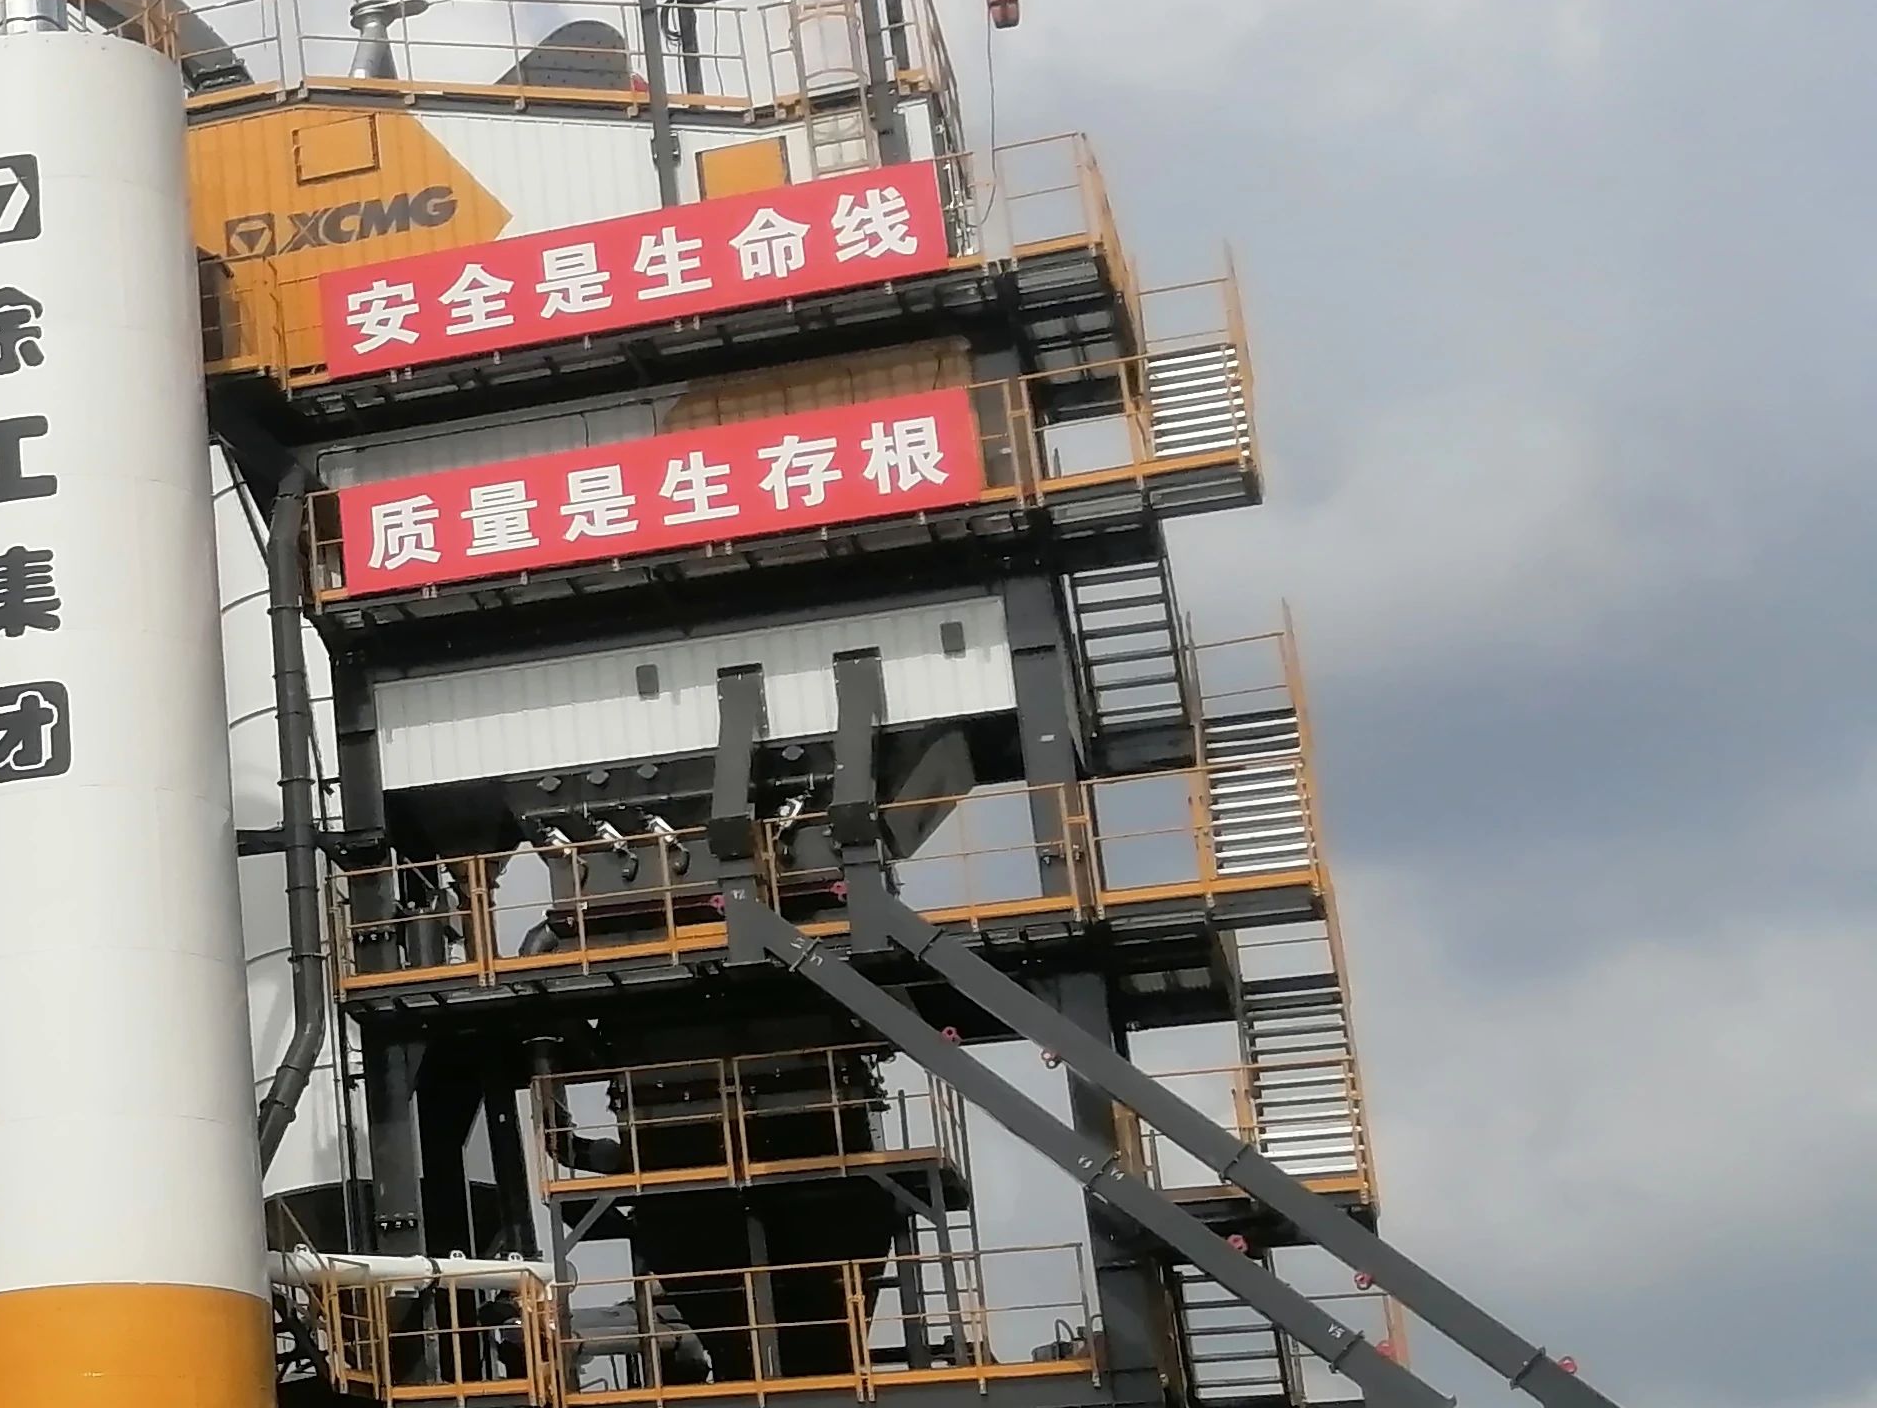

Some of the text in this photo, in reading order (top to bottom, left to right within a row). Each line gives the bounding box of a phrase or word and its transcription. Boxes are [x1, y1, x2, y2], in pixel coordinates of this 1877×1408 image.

[278, 185, 458, 255] XCMG
[345, 186, 919, 356] 安全是生命线
[367, 414, 950, 572] 质量是生存根
